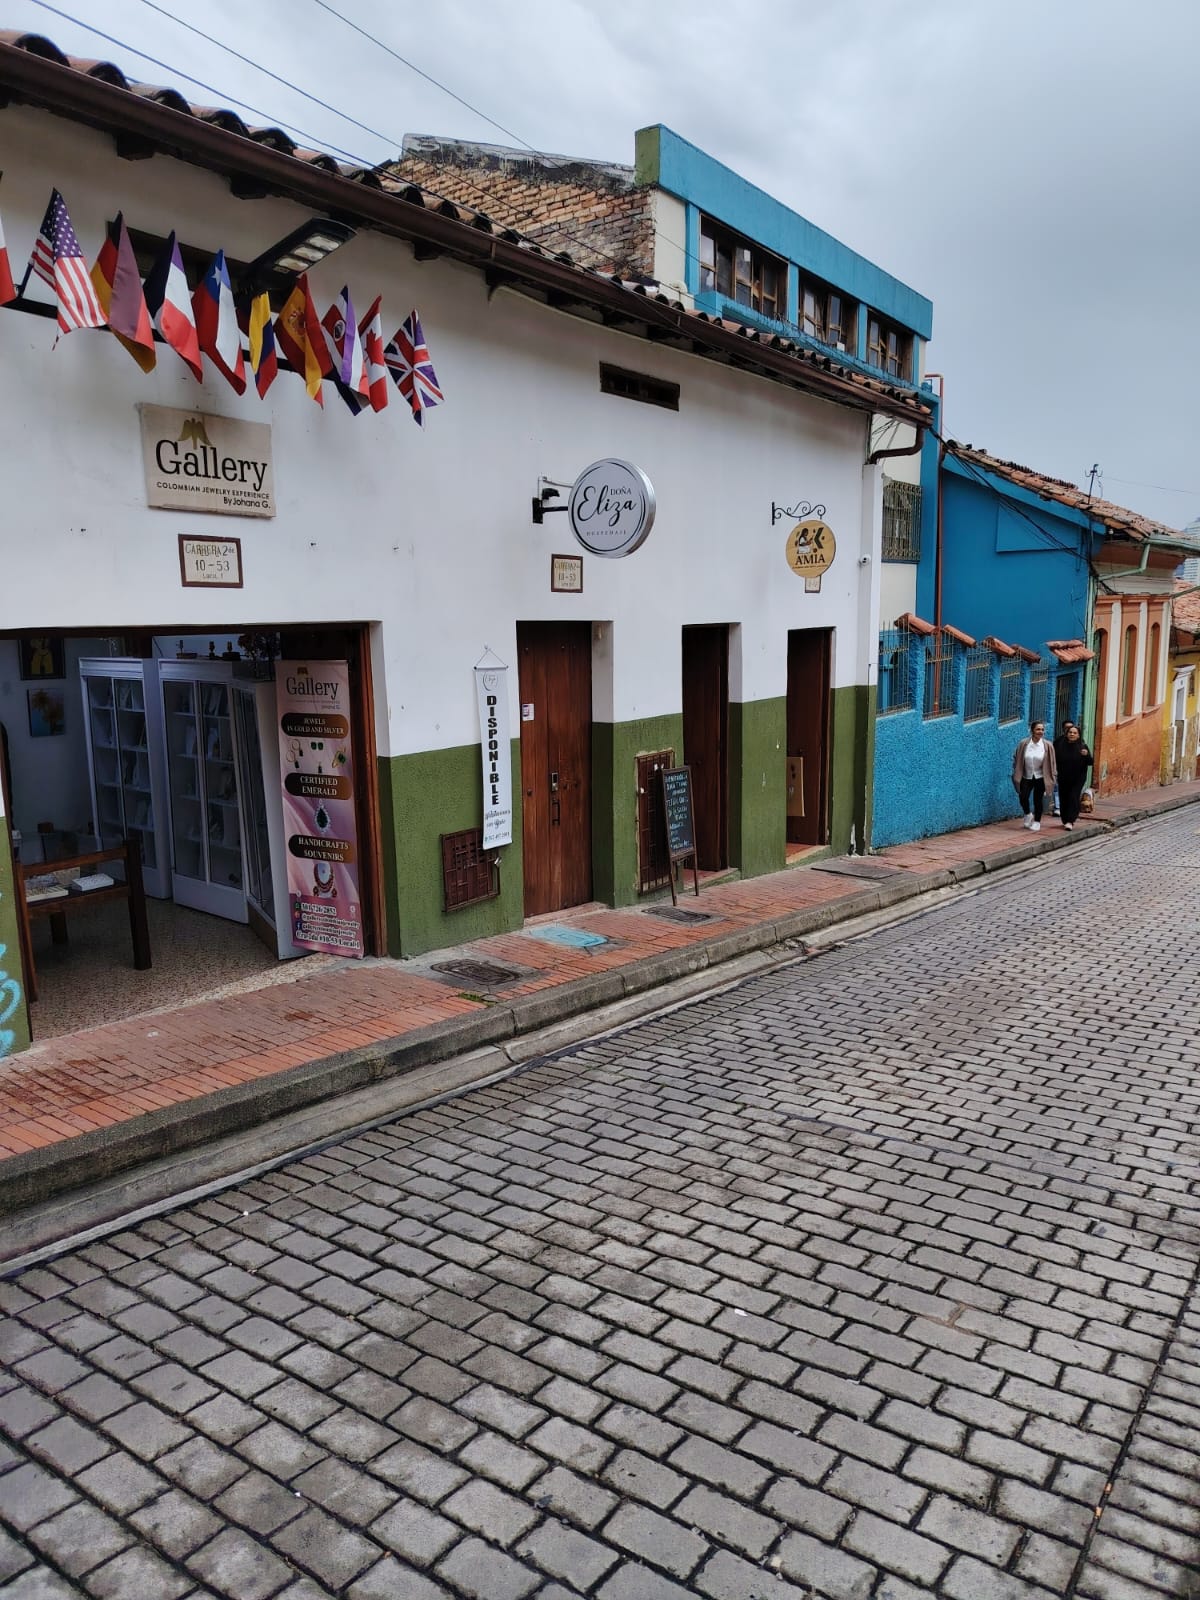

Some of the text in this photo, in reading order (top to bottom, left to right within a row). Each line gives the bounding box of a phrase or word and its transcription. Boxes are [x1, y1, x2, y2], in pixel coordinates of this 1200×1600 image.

[156, 439, 268, 492] Gallery
[156, 482, 270, 500] COLOMBIAN JEWELRY EXPERIENCE
[610, 486, 632, 496] DOÑA
[223, 497, 271, 509] By Johana G.
[578, 485, 637, 527] Eliza
[286, 677, 338, 700] Gallery
[486, 695, 500, 806] DISPONIBLE
[300, 776, 338, 786] CERTIFIED
[302, 786, 337, 796] EMERALD
[298, 837, 349, 849] HANDICRAFTS
[304, 849, 344, 862] SOUVENIRS
